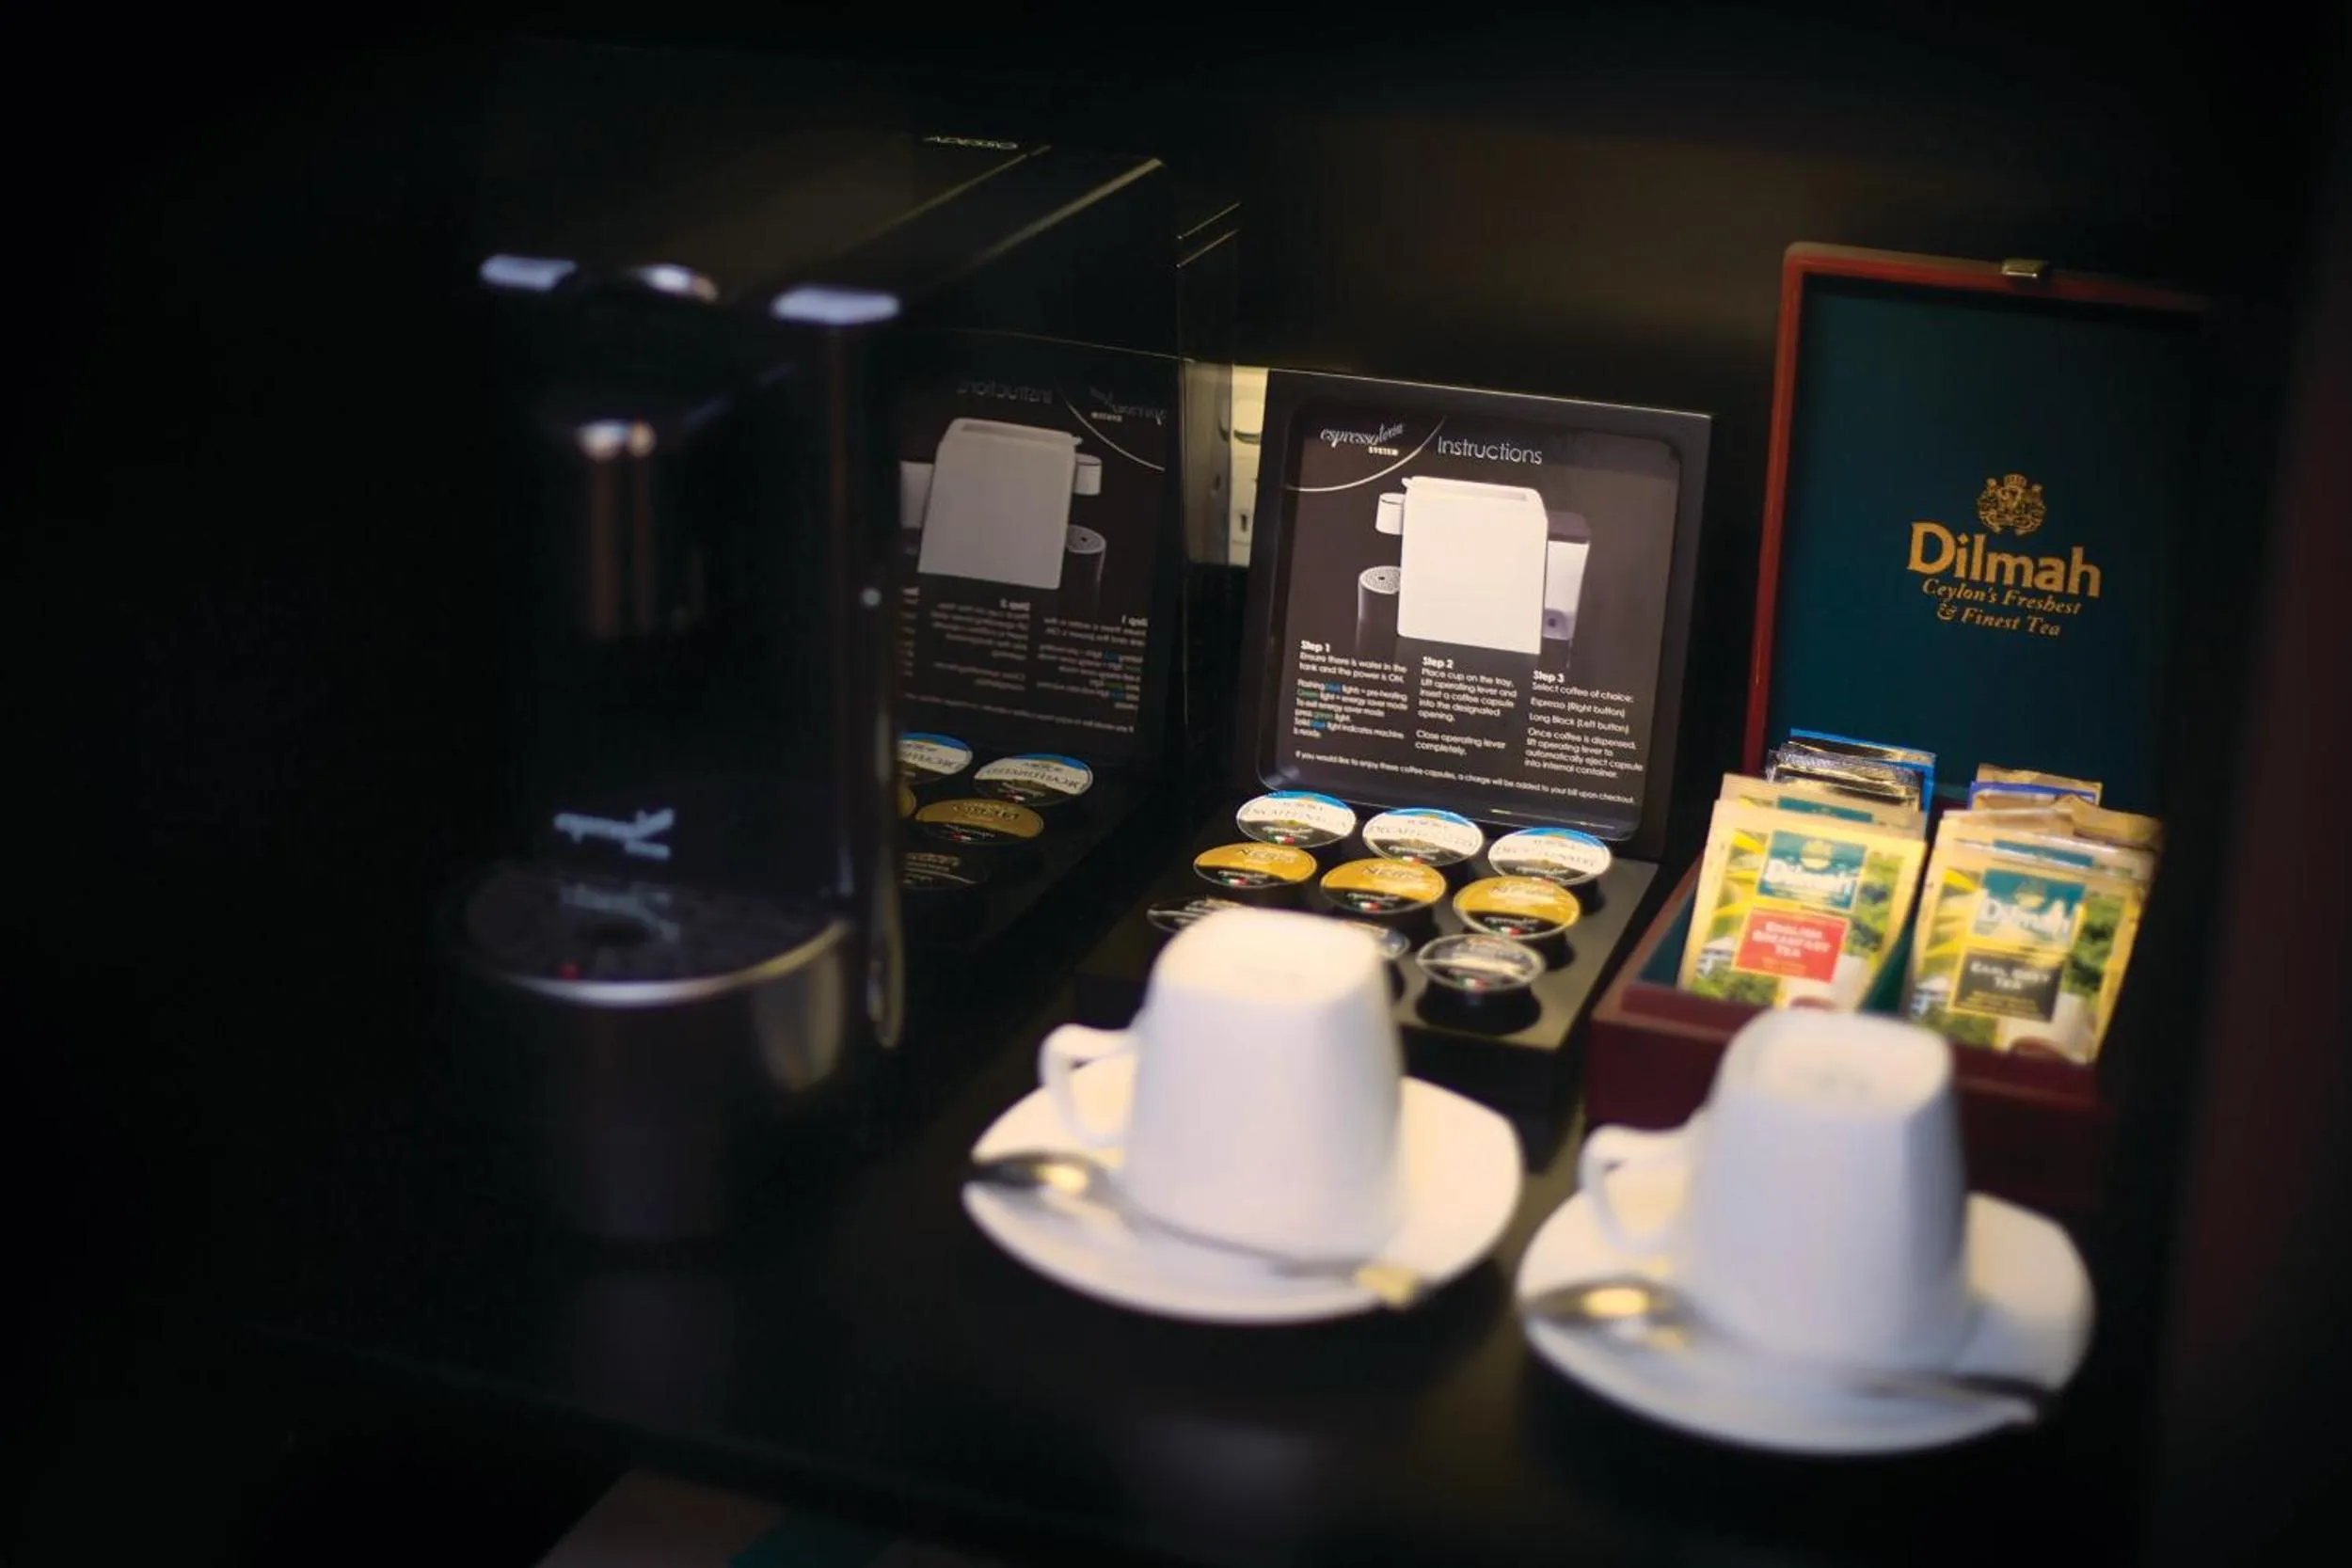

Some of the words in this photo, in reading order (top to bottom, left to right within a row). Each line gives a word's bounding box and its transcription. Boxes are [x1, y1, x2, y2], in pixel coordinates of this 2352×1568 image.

[1438, 436, 1543, 465] Instructions
[1907, 521, 2101, 597] Dilmah
[1923, 578, 1998, 603] Ceylon's
[2002, 589, 2082, 615] Freshest
[1936, 601, 1957, 620] &
[1961, 608, 2021, 630] Finest
[2026, 615, 2061, 637] Tea
[1300, 640, 1323, 653] Step
[1326, 643, 1330, 653] 1
[1300, 651, 1327, 662] Ensure
[1328, 656, 1350, 665] there
[1351, 658, 1357, 667] is
[1359, 660, 1382, 670] water
[1383, 662, 1391, 671] in
[1392, 664, 1407, 673] the
[1422, 657, 1445, 669] Step
[1446, 659, 1454, 669] 2
[1299, 662, 1317, 672] tank
[1318, 665, 1337, 673] and
[1338, 667, 1352, 676] the
[1353, 670, 1379, 679] power
[1422, 668, 1446, 678] Place
[1447, 672, 1465, 681] cup
[1466, 673, 1478, 682] on
[1479, 675, 1493, 684] the
[1534, 670, 1556, 683] Step
[1558, 673, 1565, 683] 3
[1421, 677, 1433, 686] Lift
[1434, 681, 1476, 694] operating
[1477, 685, 1498, 695] lever
[1499, 689, 1518, 698] and
[1533, 683, 1559, 692] Select
[1560, 687, 1588, 697] coffee
[1342, 696, 1366, 706] energy
[1420, 689, 1441, 698] insert
[1451, 693, 1479, 703] coffee
[1481, 698, 1515, 708] capsule
[1531, 697, 1565, 708] Espresso
[1419, 699, 1435, 708] into
[1436, 701, 1451, 709] the
[1452, 704, 1501, 717] designated
[1529, 713, 1550, 724] Long
[1552, 715, 1575, 725] Black
[1374, 729, 1405, 739] machine
[1416, 730, 1439, 740] Close
[1440, 735, 1483, 748] operating
[1484, 738, 1505, 749] lever
[1528, 727, 1552, 738] Once
[1554, 732, 1582, 742] coffee
[1537, 741, 1580, 753] operating
[1581, 745, 1603, 754] lever
[1604, 749, 1613, 757] to
[1524, 759, 1541, 768] into
[1543, 762, 1575, 772] internal
[1525, 750, 1583, 764] automatically
[1585, 756, 1608, 766] eject
[1609, 760, 1644, 771] capsule
[1302, 752, 1314, 761] you
[1315, 754, 1337, 763] would
[1338, 756, 1349, 765] like
[1359, 760, 1379, 769] enjoy
[1380, 762, 1399, 772] these
[1400, 766, 1423, 775] coffee
[1465, 774, 1491, 785] charge
[1492, 777, 1503, 785] will
[1516, 782, 1540, 791] added
[1550, 786, 1567, 795] your
[1567, 788, 1578, 797] bill
[1579, 791, 1598, 800] upon
